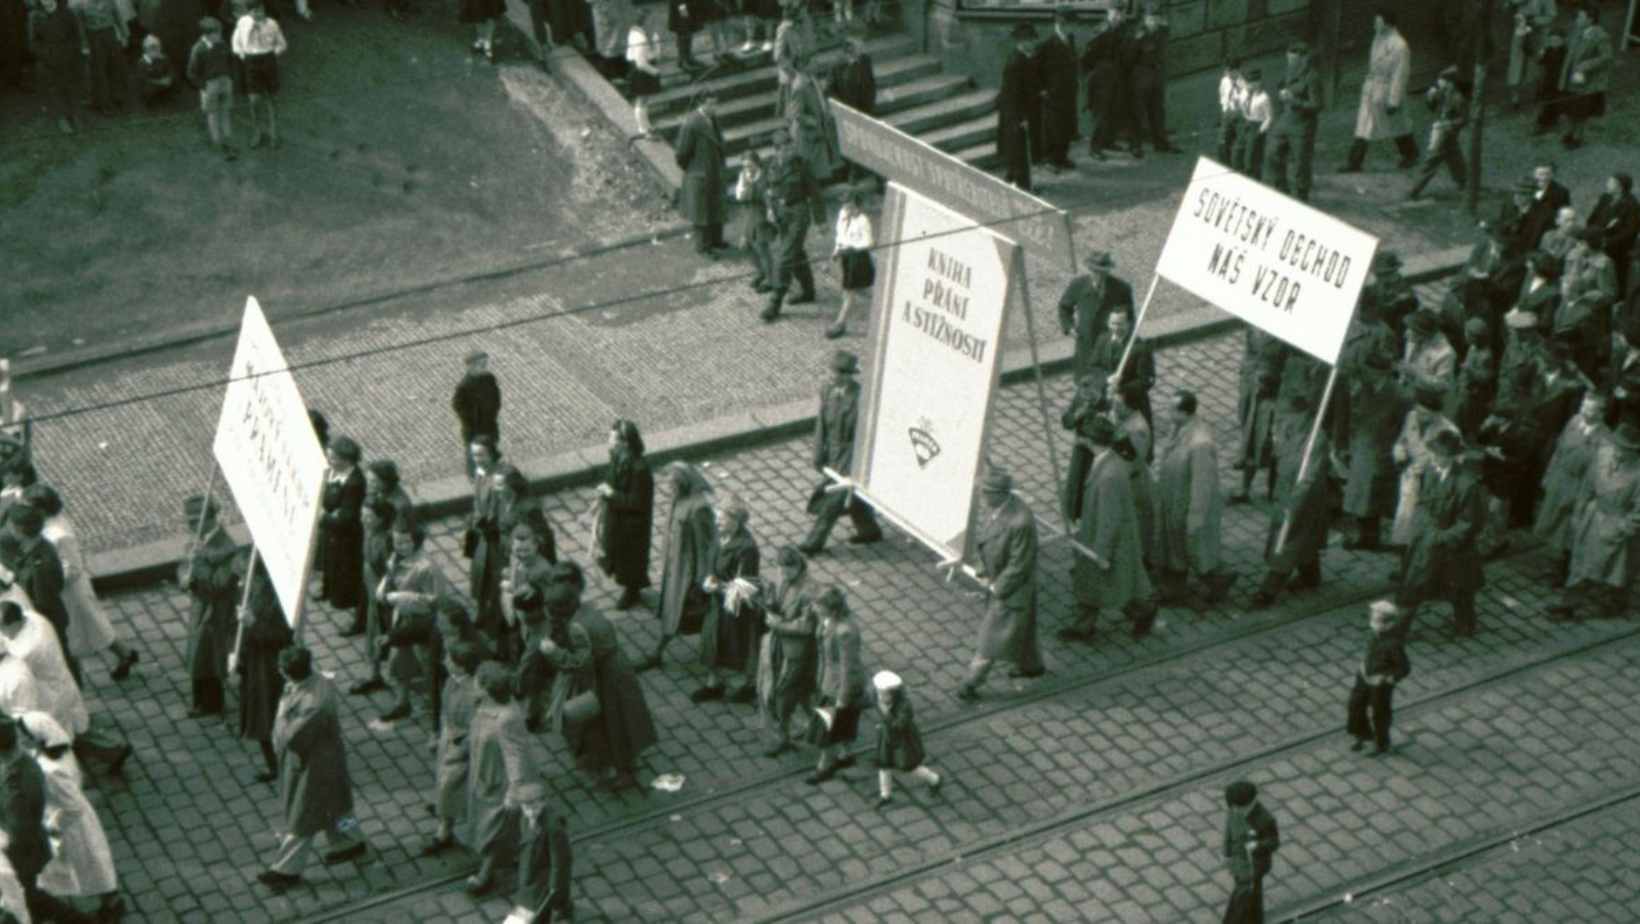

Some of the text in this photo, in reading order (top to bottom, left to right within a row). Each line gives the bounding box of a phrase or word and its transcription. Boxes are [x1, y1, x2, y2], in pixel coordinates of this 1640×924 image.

[928, 247, 972, 288] KNIHA
[1279, 229, 1351, 289] OBCHOD
[903, 300, 911, 322] A
[1252, 264, 1301, 313] VZOR
